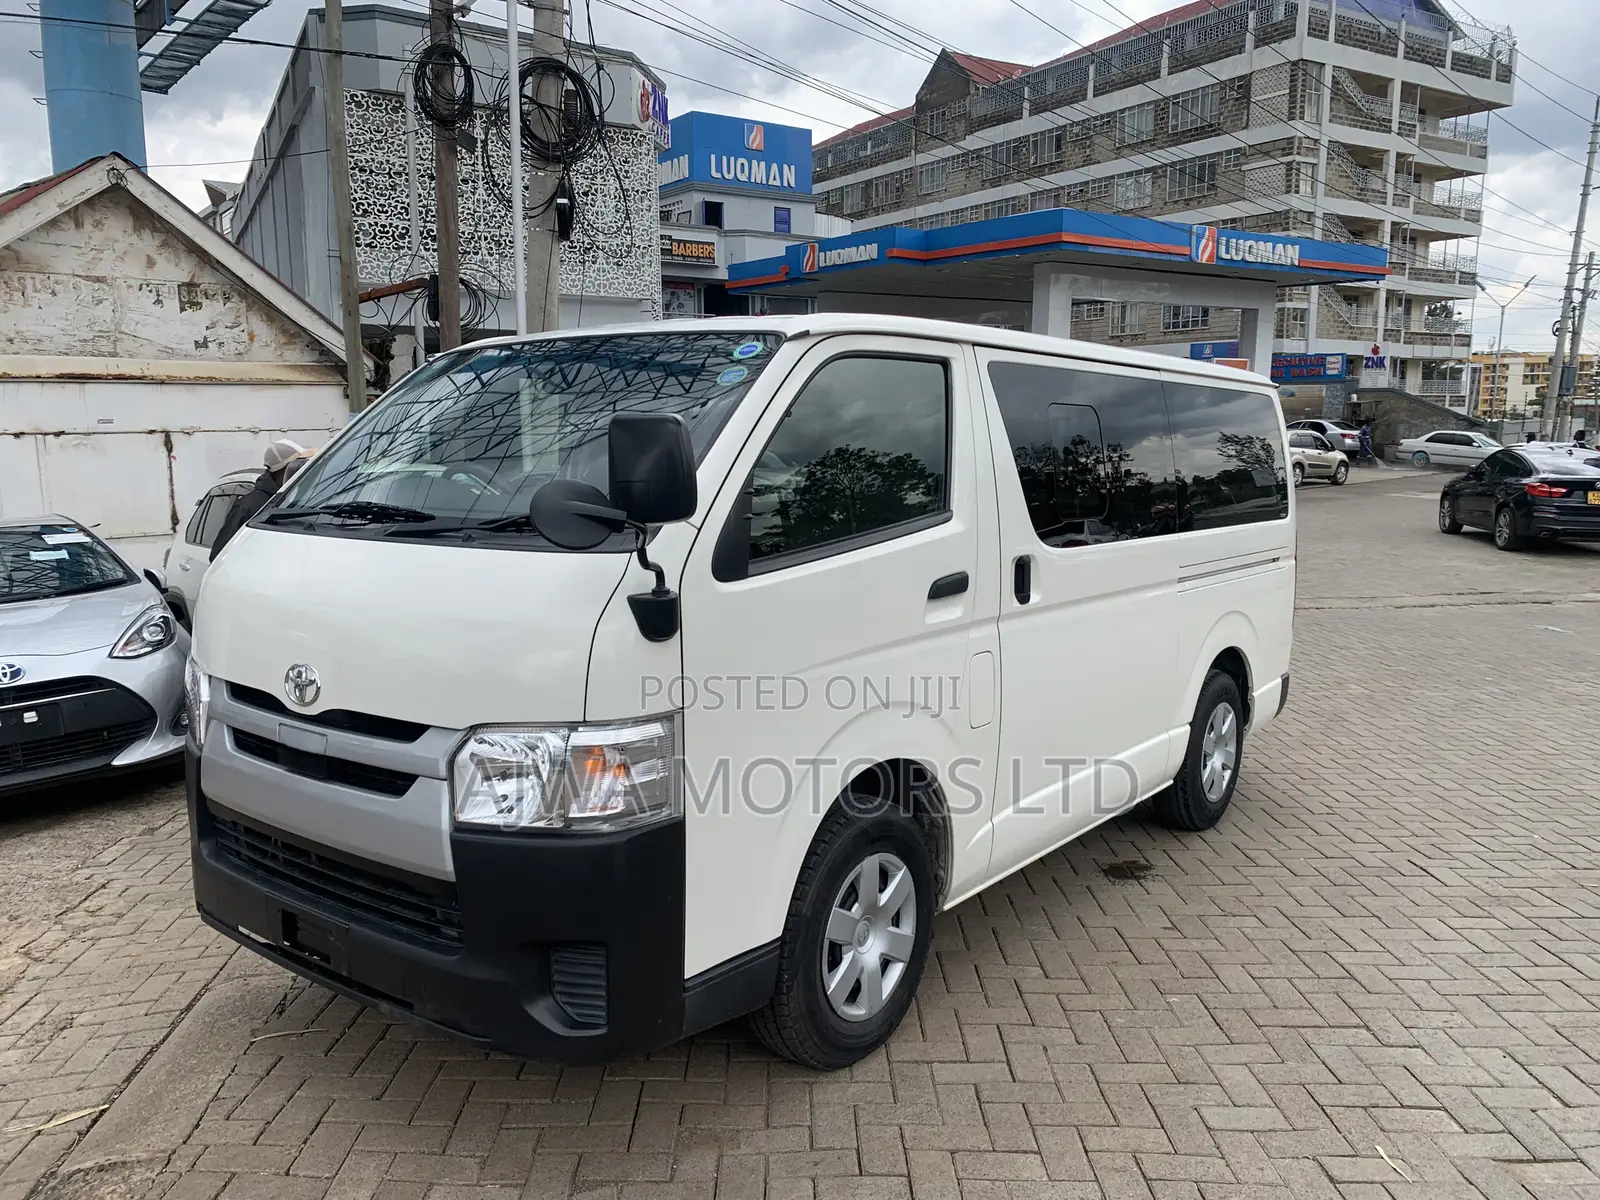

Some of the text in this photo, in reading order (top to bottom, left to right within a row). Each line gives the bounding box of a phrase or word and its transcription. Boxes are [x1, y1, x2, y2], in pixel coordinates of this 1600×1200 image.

[710, 154, 795, 188] LUQMAN
[672, 242, 715, 258] BARBERS
[819, 243, 878, 267] LUQMAN
[1219, 237, 1300, 266] LUQMAN
[1272, 356, 1325, 366] ECUTIVE
[1364, 356, 1386, 368] ZNK
[1272, 368, 1323, 377] AR WASH
